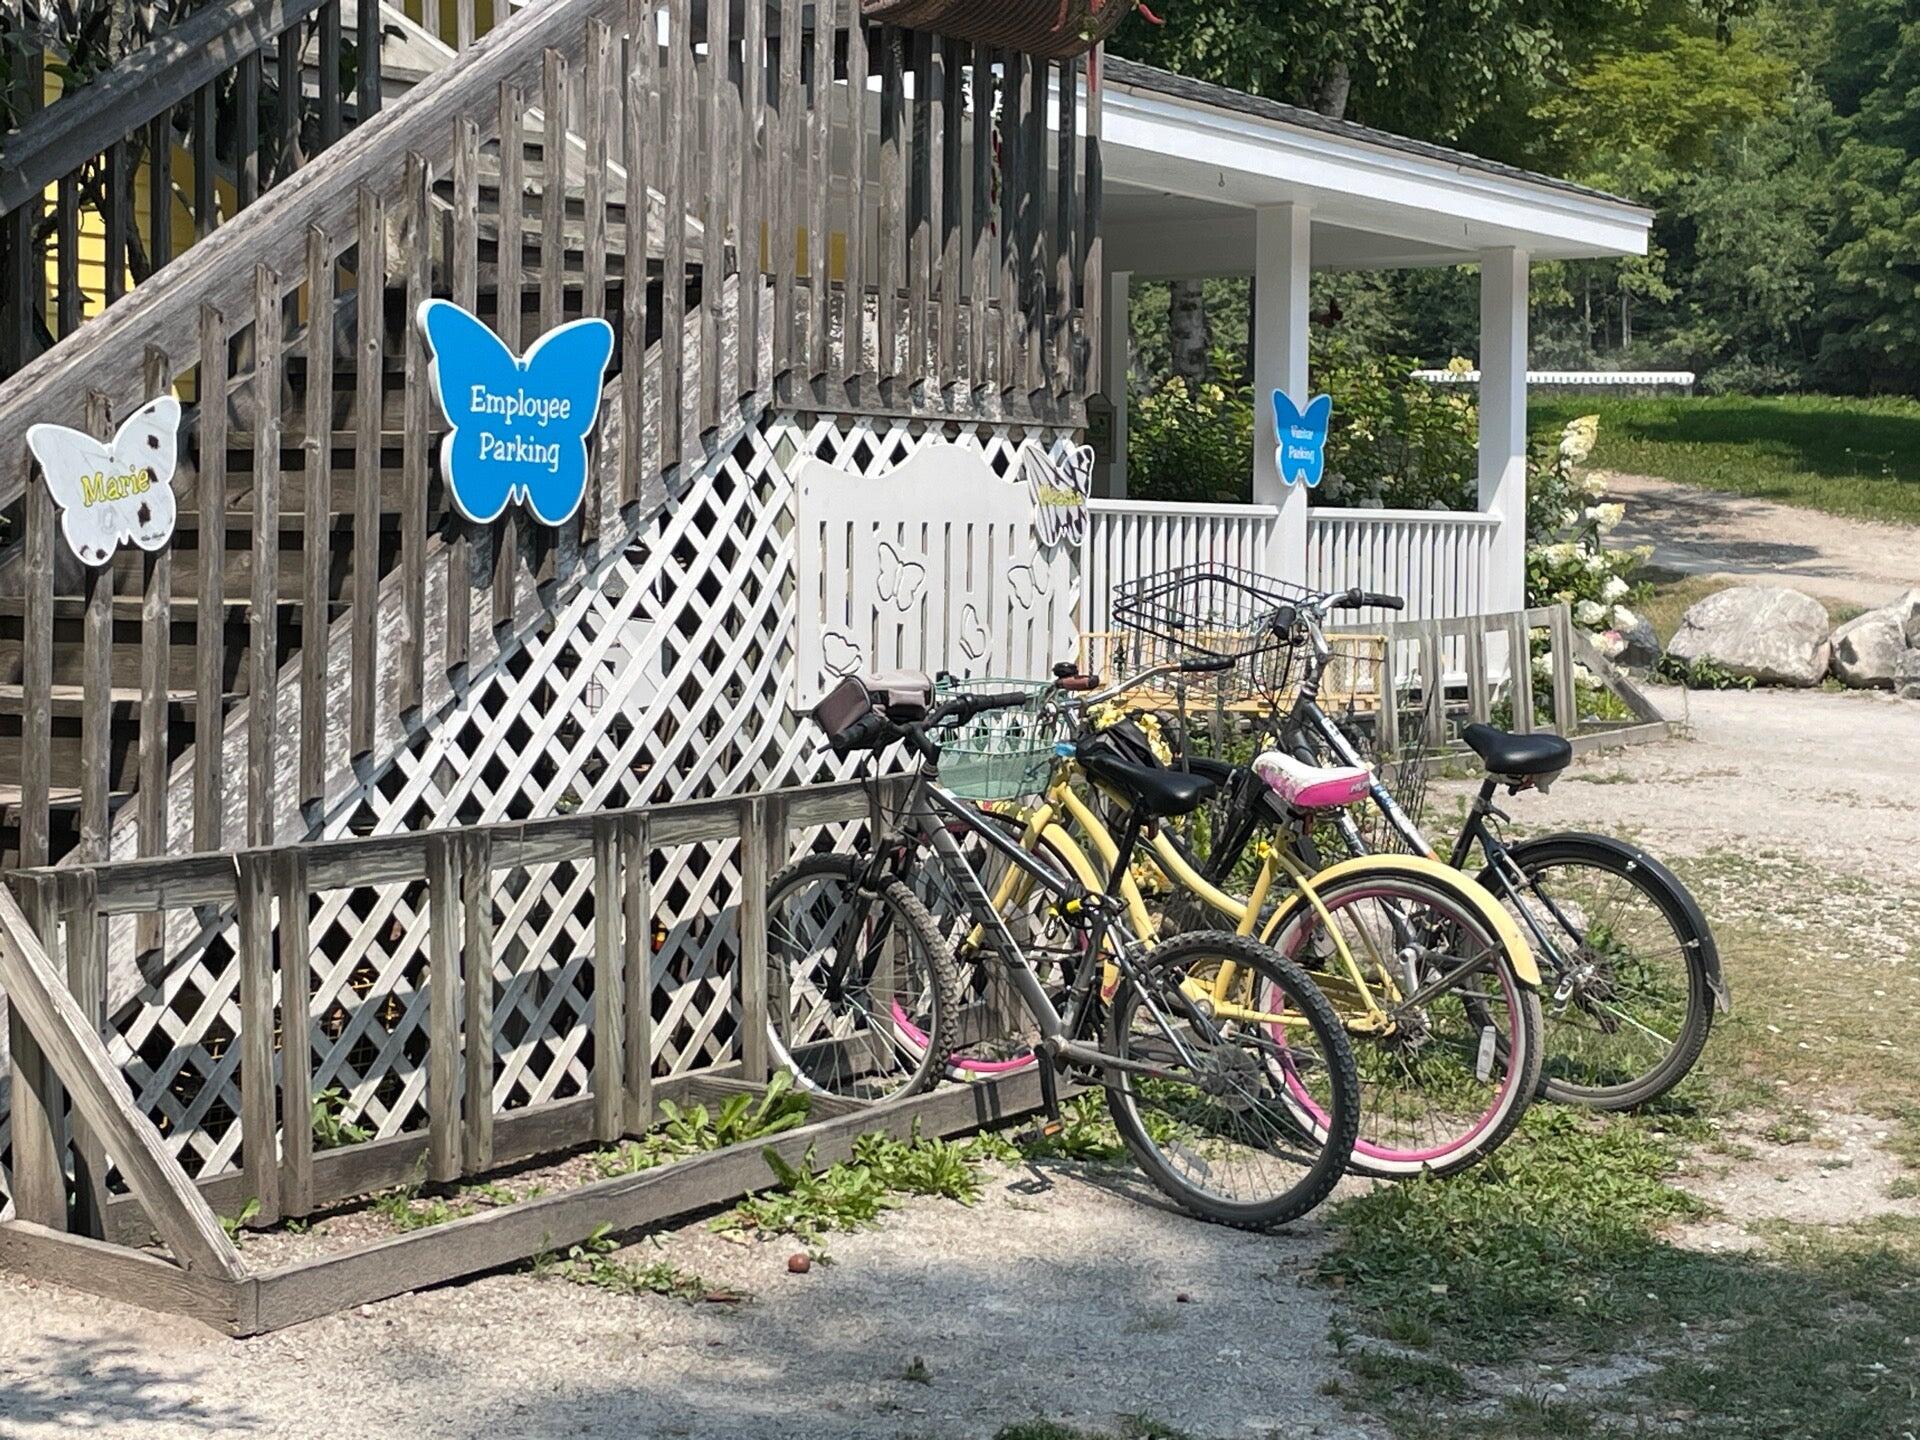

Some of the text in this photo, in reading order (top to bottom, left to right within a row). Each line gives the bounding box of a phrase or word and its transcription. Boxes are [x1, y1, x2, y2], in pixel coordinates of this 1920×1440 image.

[470, 385, 571, 427] Employee
[479, 432, 560, 473] Parking
[81, 464, 151, 507] Marie
